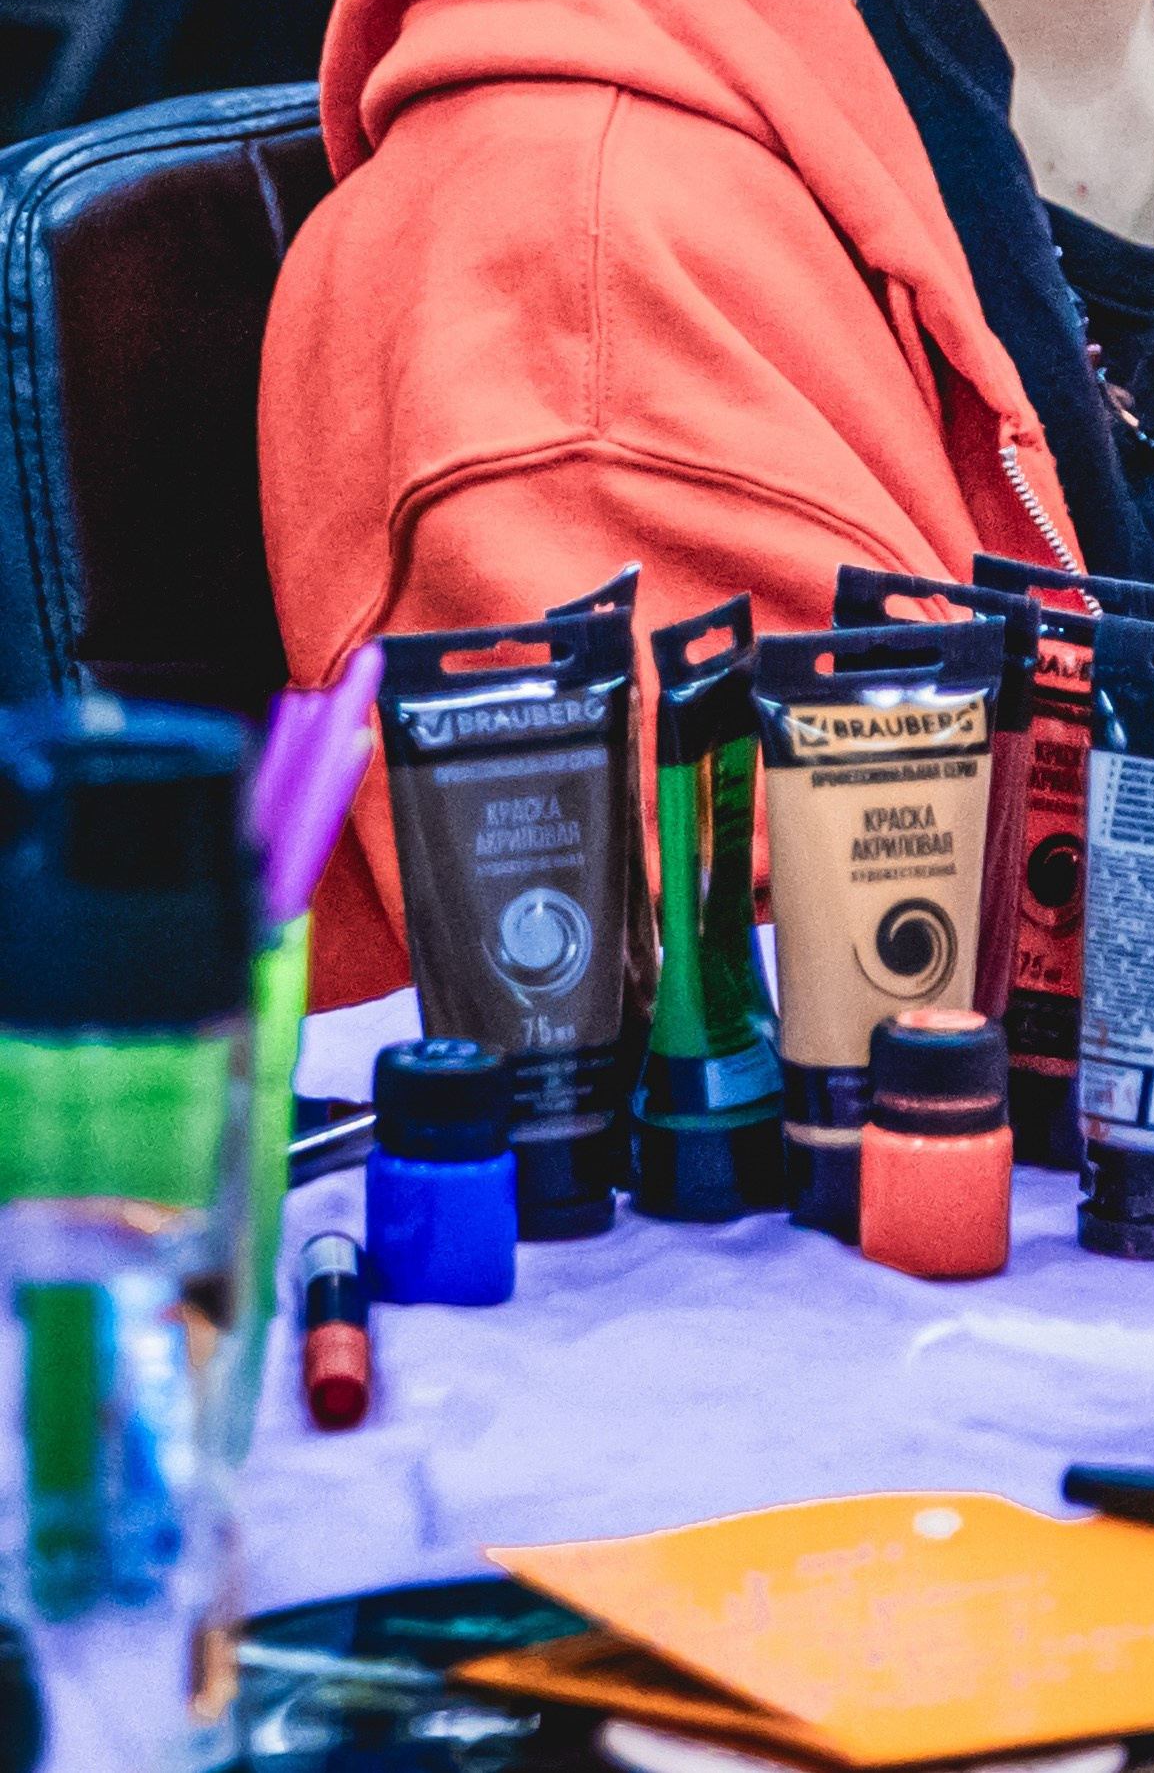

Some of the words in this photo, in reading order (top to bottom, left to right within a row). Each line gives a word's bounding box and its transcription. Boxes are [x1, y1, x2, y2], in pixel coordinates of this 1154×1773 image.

[457, 698, 606, 735] BRAUBERG
[833, 709, 973, 738] BRAUBERG
[864, 803, 937, 833] КРАСКА
[851, 832, 954, 862] АКРИЛОВАЯ
